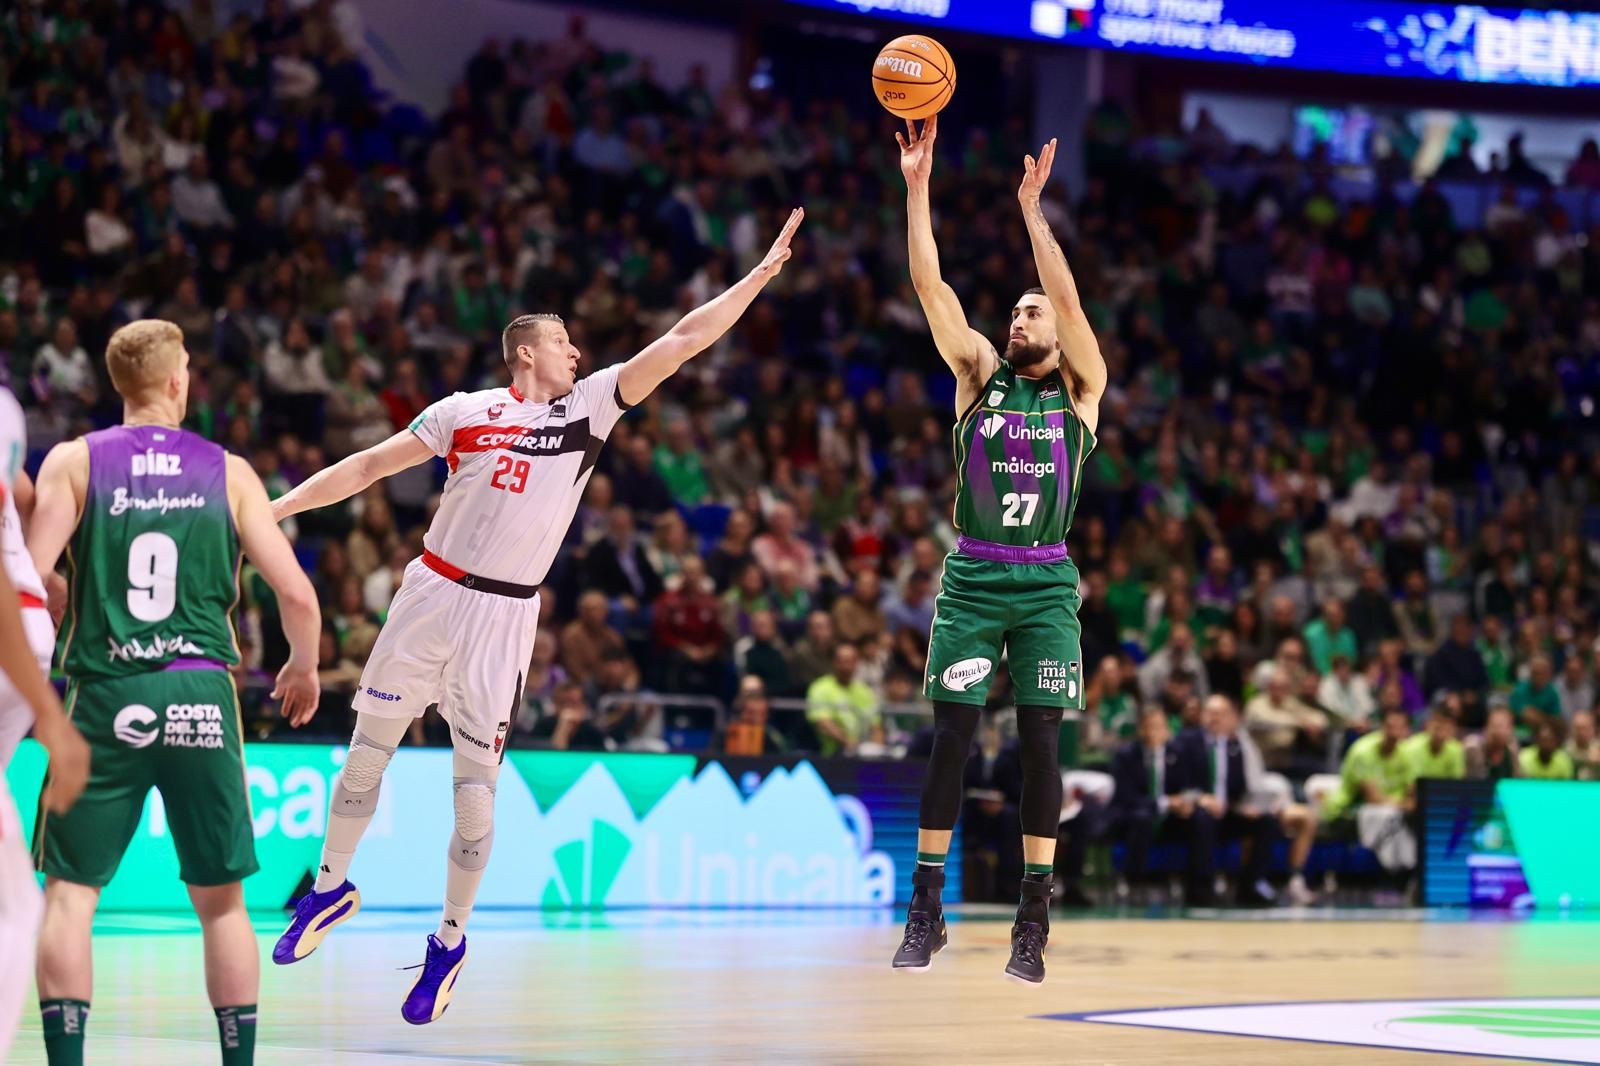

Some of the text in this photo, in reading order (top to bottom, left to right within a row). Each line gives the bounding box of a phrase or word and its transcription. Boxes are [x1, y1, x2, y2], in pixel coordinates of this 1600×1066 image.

[876, 57, 922, 77] Wilson
[1008, 424, 1064, 443] Unicaja
[131, 447, 183, 477] DÍAZ
[490, 455, 531, 494] 29
[1002, 492, 1040, 527] 27
[127, 532, 179, 622] 9
[1038, 658, 1060, 666] sabor
[1043, 662, 1067, 678] má
[1037, 674, 1067, 694] laga
[165, 703, 223, 721] COSTA
[164, 720, 224, 735] DEL SOL
[457, 727, 491, 750] BERNER
